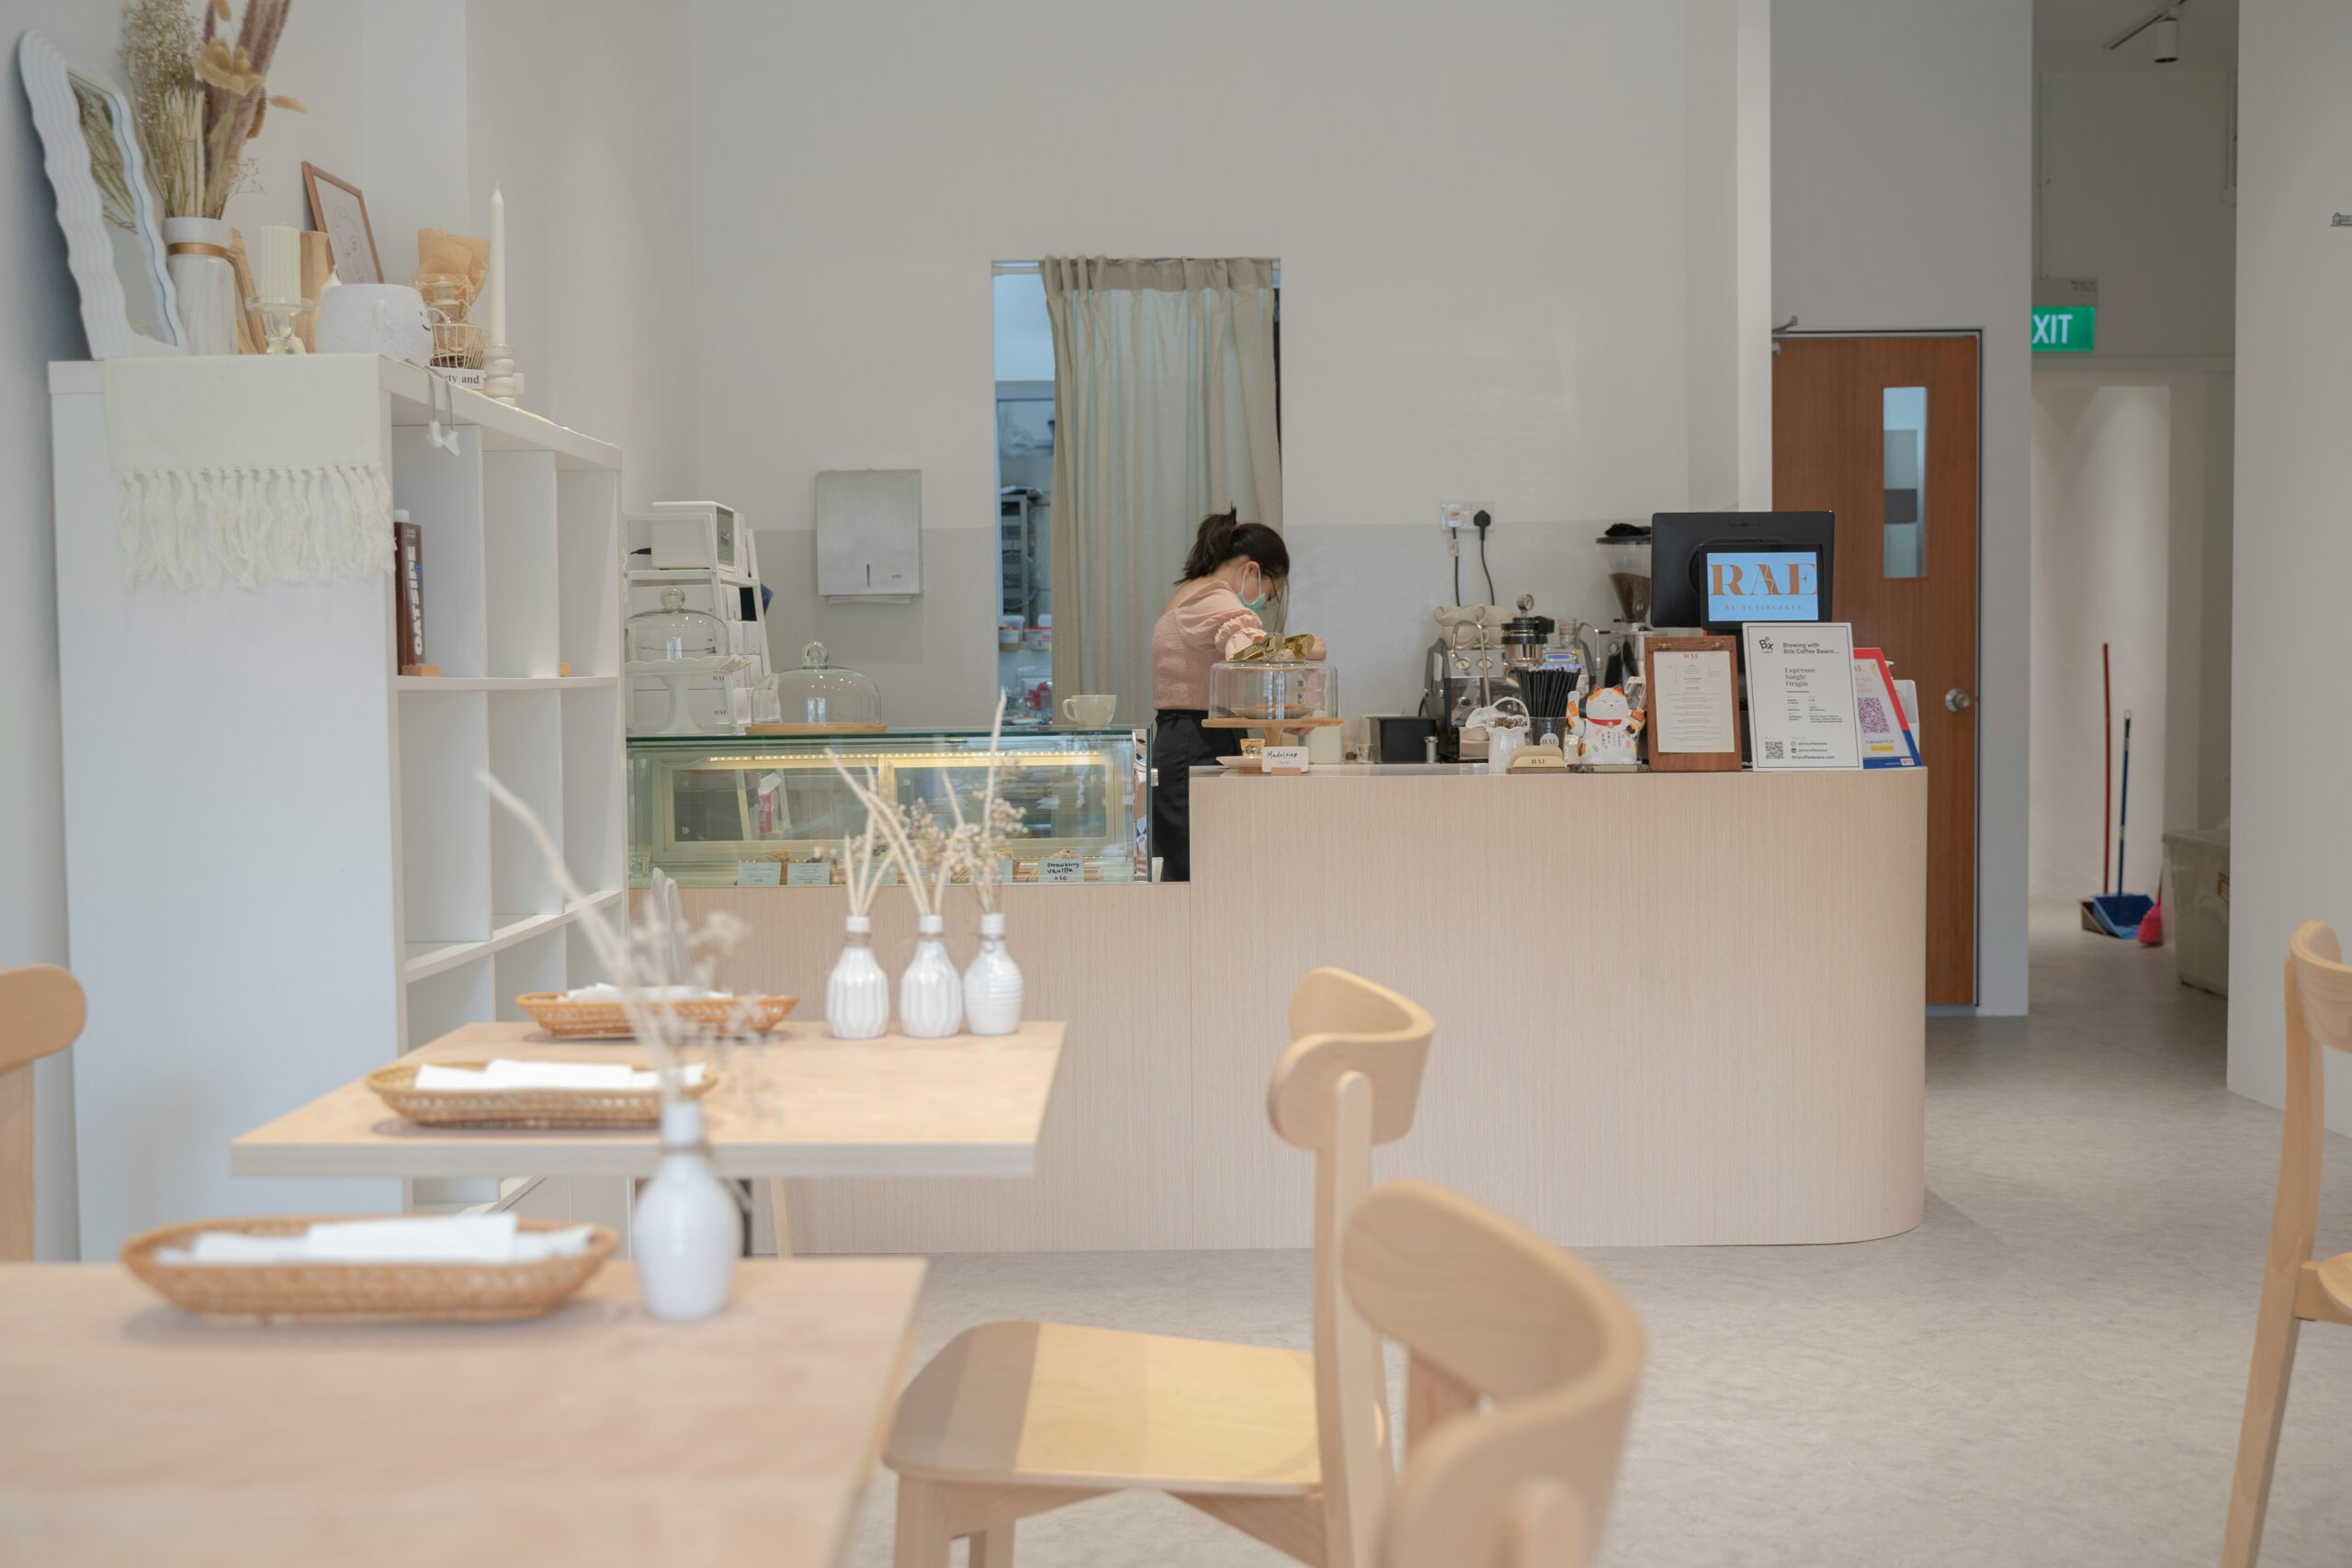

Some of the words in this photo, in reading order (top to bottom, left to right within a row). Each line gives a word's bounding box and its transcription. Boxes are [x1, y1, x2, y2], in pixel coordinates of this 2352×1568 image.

[2031, 313, 2074, 344] XIT
[461, 375, 480, 384] and
[1708, 563, 1818, 596] RAE
[407, 546, 423, 656] OATSIDE
